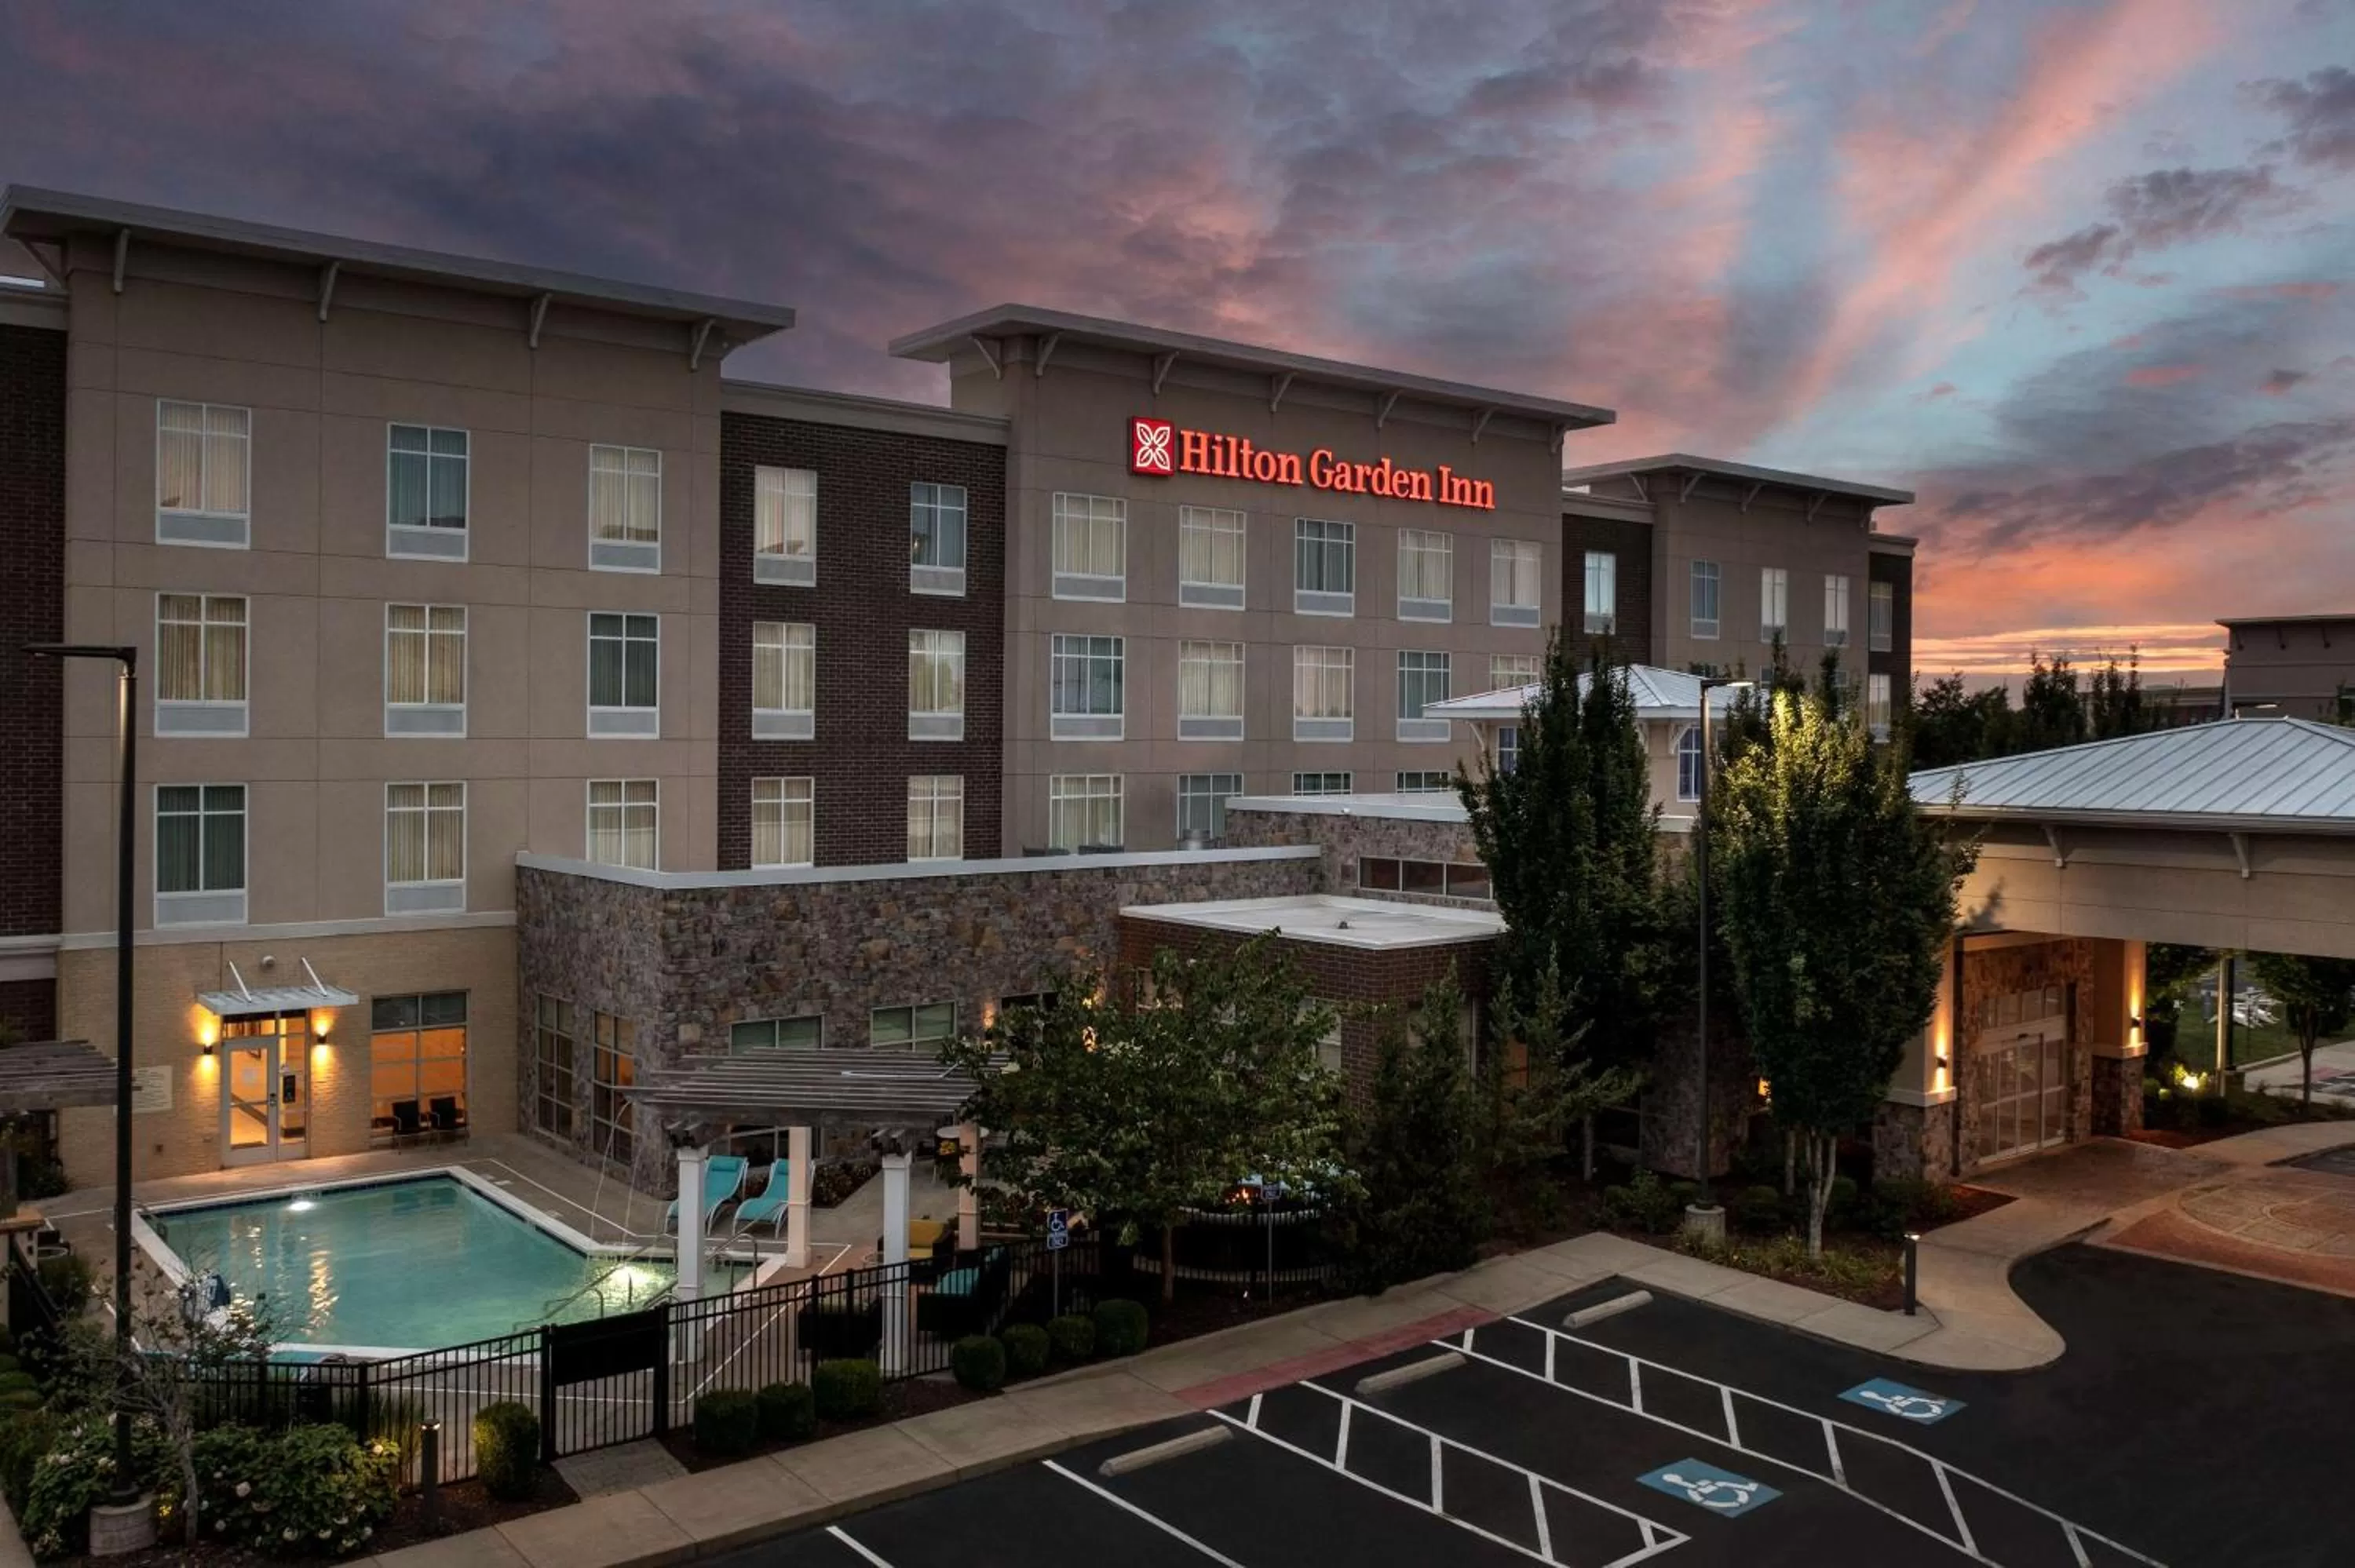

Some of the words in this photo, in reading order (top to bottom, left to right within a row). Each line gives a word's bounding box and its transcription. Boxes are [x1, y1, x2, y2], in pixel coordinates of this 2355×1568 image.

[1180, 430, 1303, 484] Hilton
[1310, 450, 1433, 500] Garden
[1439, 465, 1495, 509] Inn
